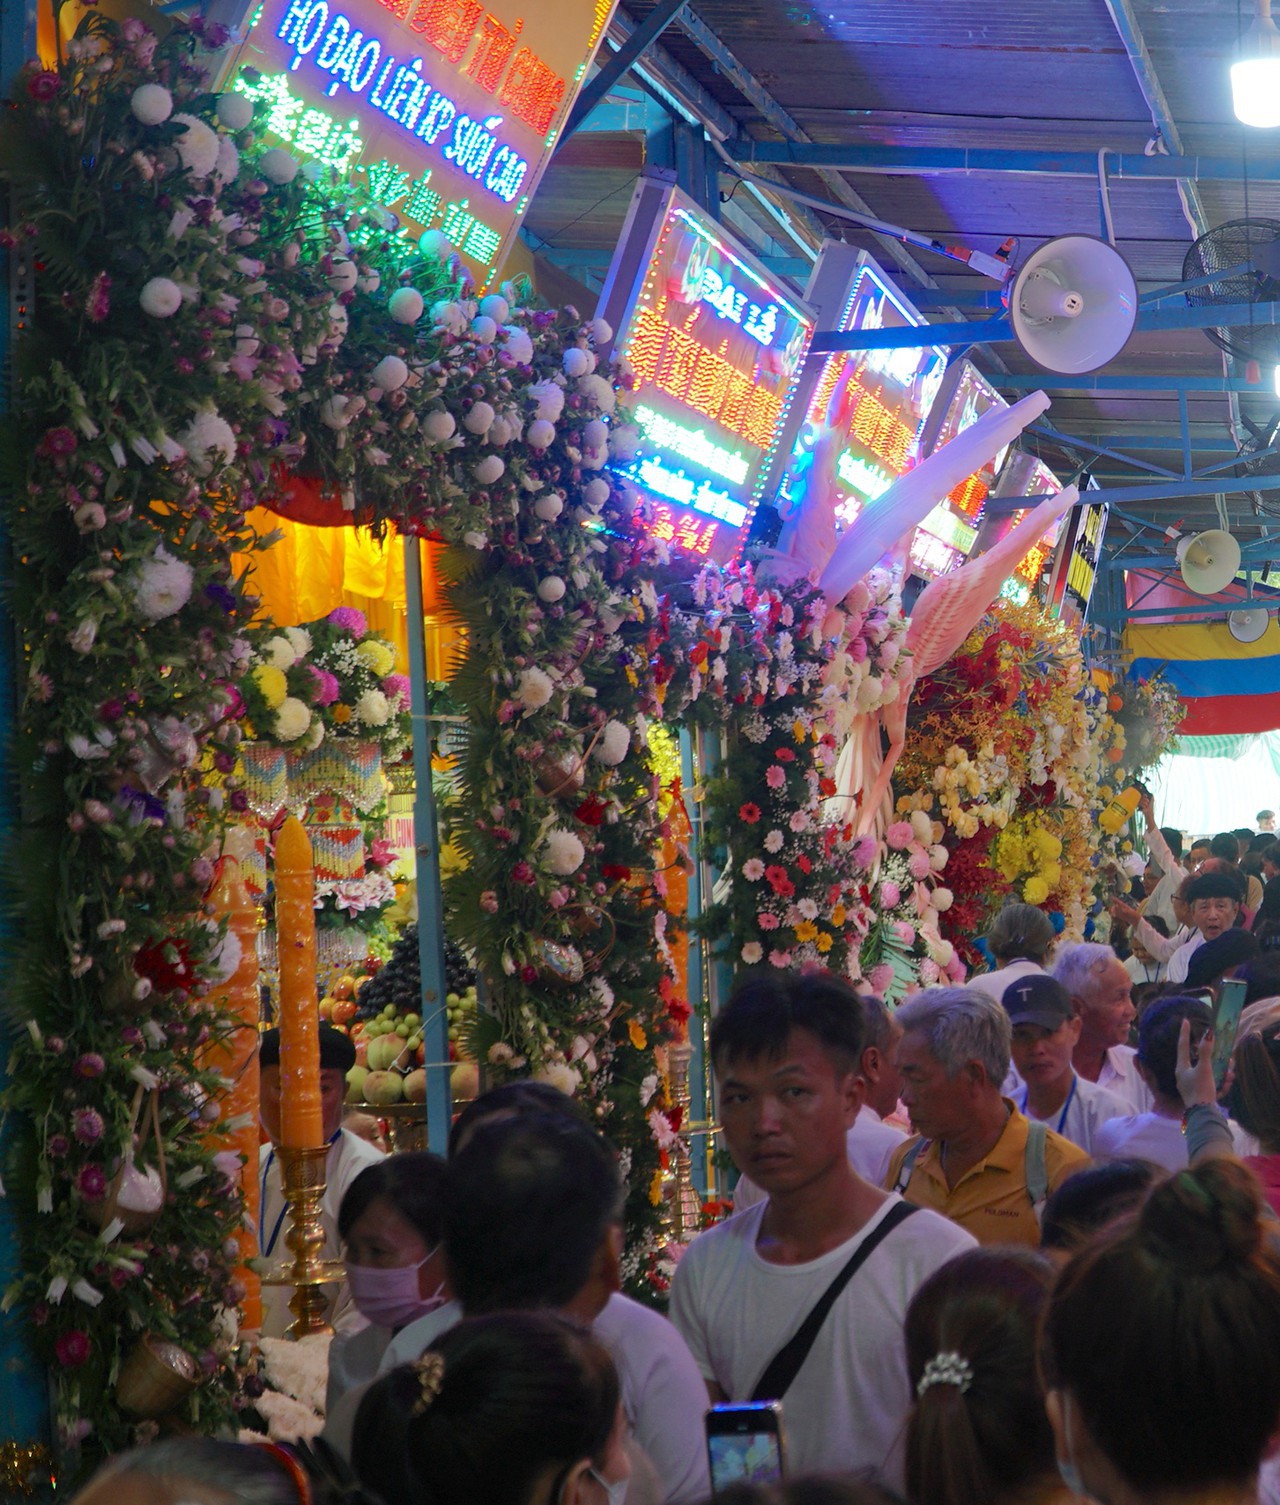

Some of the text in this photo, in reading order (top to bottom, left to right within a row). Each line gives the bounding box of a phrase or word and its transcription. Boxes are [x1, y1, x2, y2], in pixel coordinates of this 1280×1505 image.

[316, 14, 381, 97] ĐẠO
[368, 56, 432, 130] LIÊN
[443, 114, 504, 181] SUỐI
[484, 144, 528, 203] CAO
[1016, 987, 1033, 1002] T
